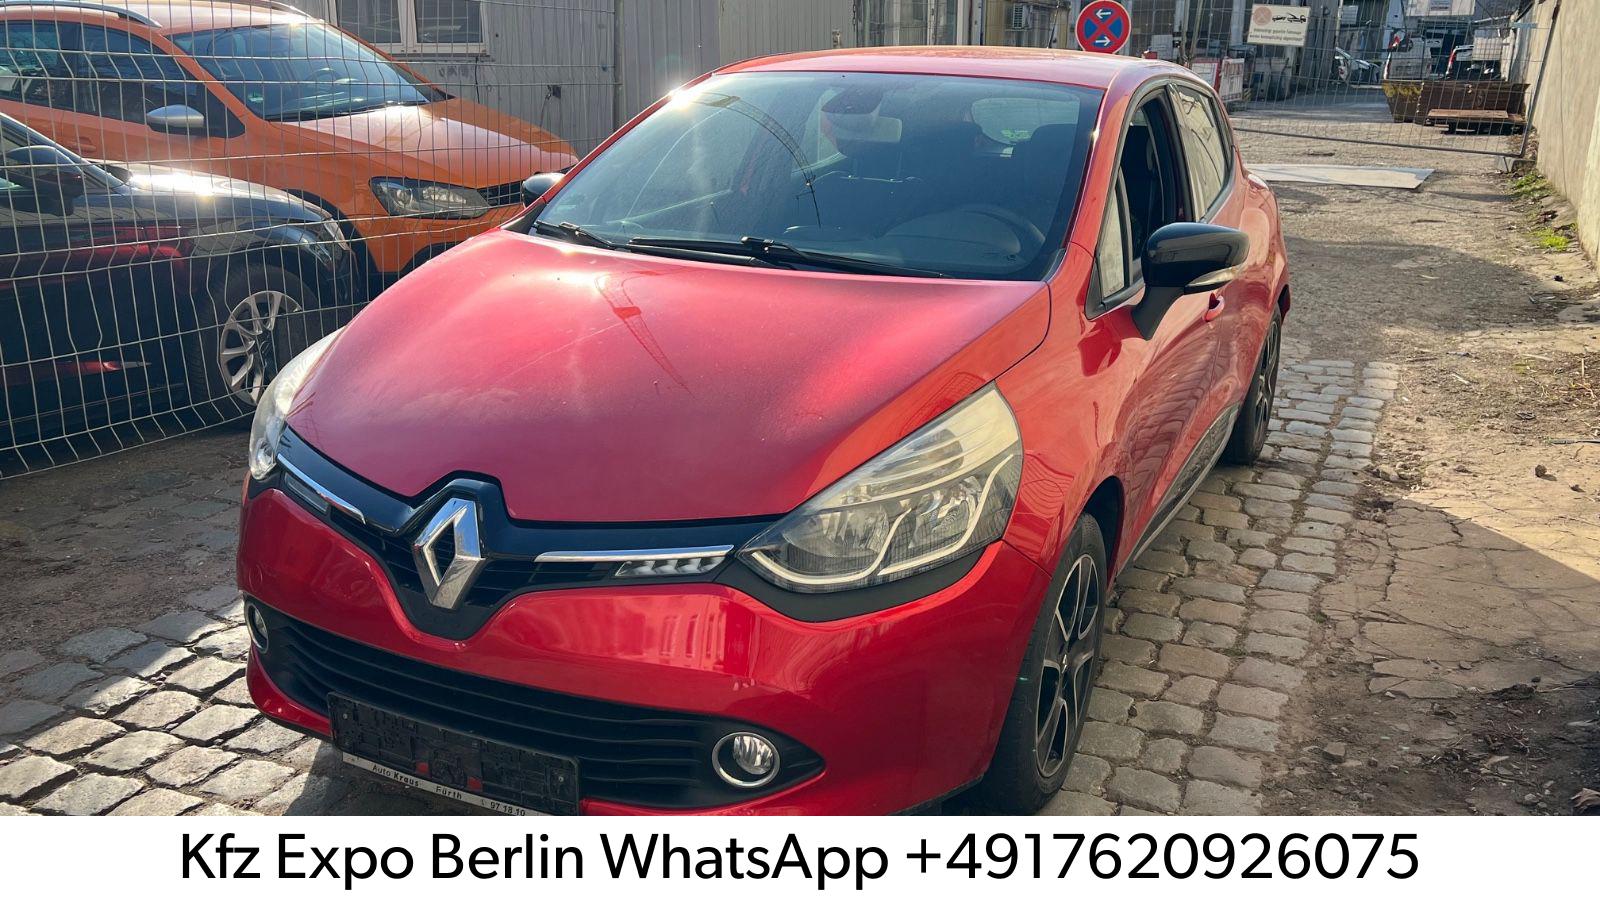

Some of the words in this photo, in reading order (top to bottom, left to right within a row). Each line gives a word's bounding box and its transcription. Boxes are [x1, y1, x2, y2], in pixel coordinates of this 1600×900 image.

[372, 764, 391, 777] Auto
[393, 771, 419, 787] Kraus
[435, 785, 462, 800] Fürth
[490, 801, 500, 810] 97
